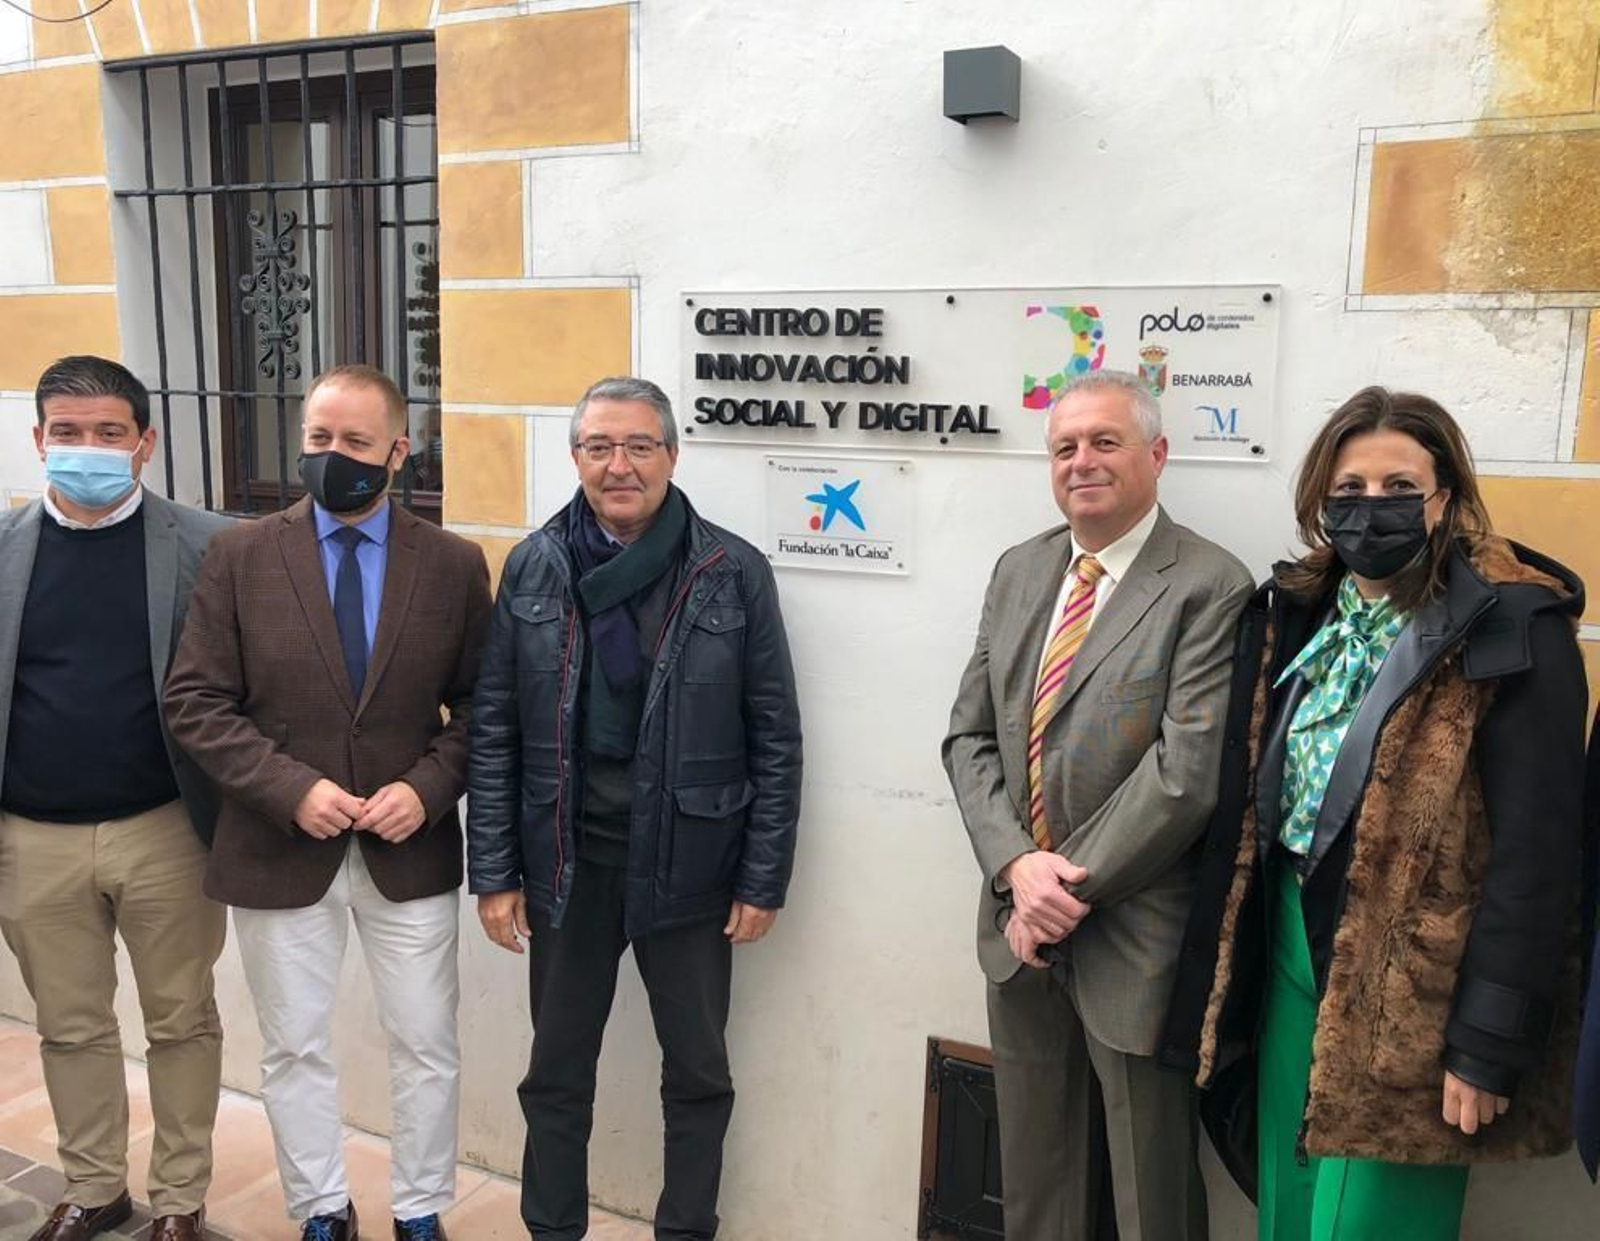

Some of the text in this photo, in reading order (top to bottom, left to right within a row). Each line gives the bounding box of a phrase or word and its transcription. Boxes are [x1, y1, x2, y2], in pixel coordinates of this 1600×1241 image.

[694, 308, 883, 336] CENTRO DE
[695, 346, 910, 385] INNOVACIÓN
[1172, 373, 1252, 387] BENARRABÁ
[694, 397, 1001, 434] SOCIAL Y DIGITAL
[778, 539, 837, 556] Fundación
